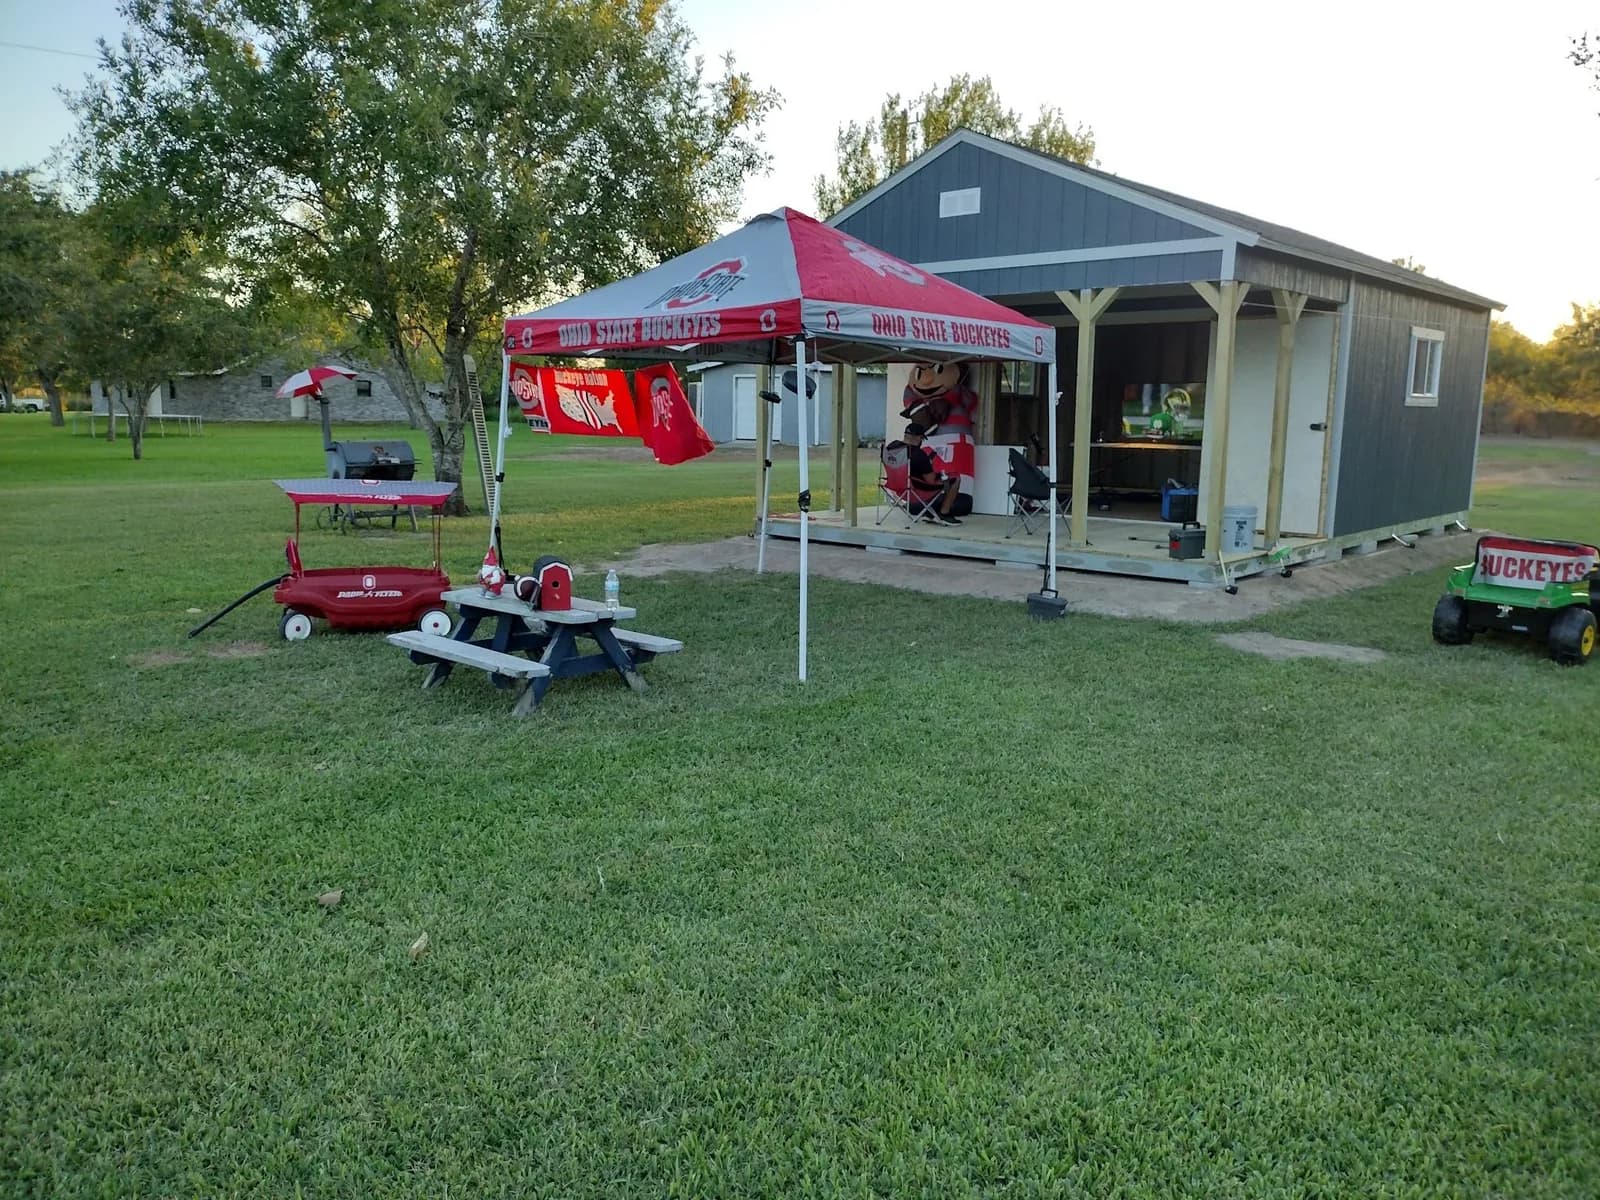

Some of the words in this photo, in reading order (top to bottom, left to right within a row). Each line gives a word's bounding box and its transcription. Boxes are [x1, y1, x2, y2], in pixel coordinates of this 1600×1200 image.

[558, 322, 592, 347] OHIO
[595, 319, 637, 344] STATE
[641, 313, 721, 341] BUCKEYES
[872, 312, 906, 337] OHIO
[911, 316, 949, 342] STATE
[951, 321, 1011, 349] BUCKEYES
